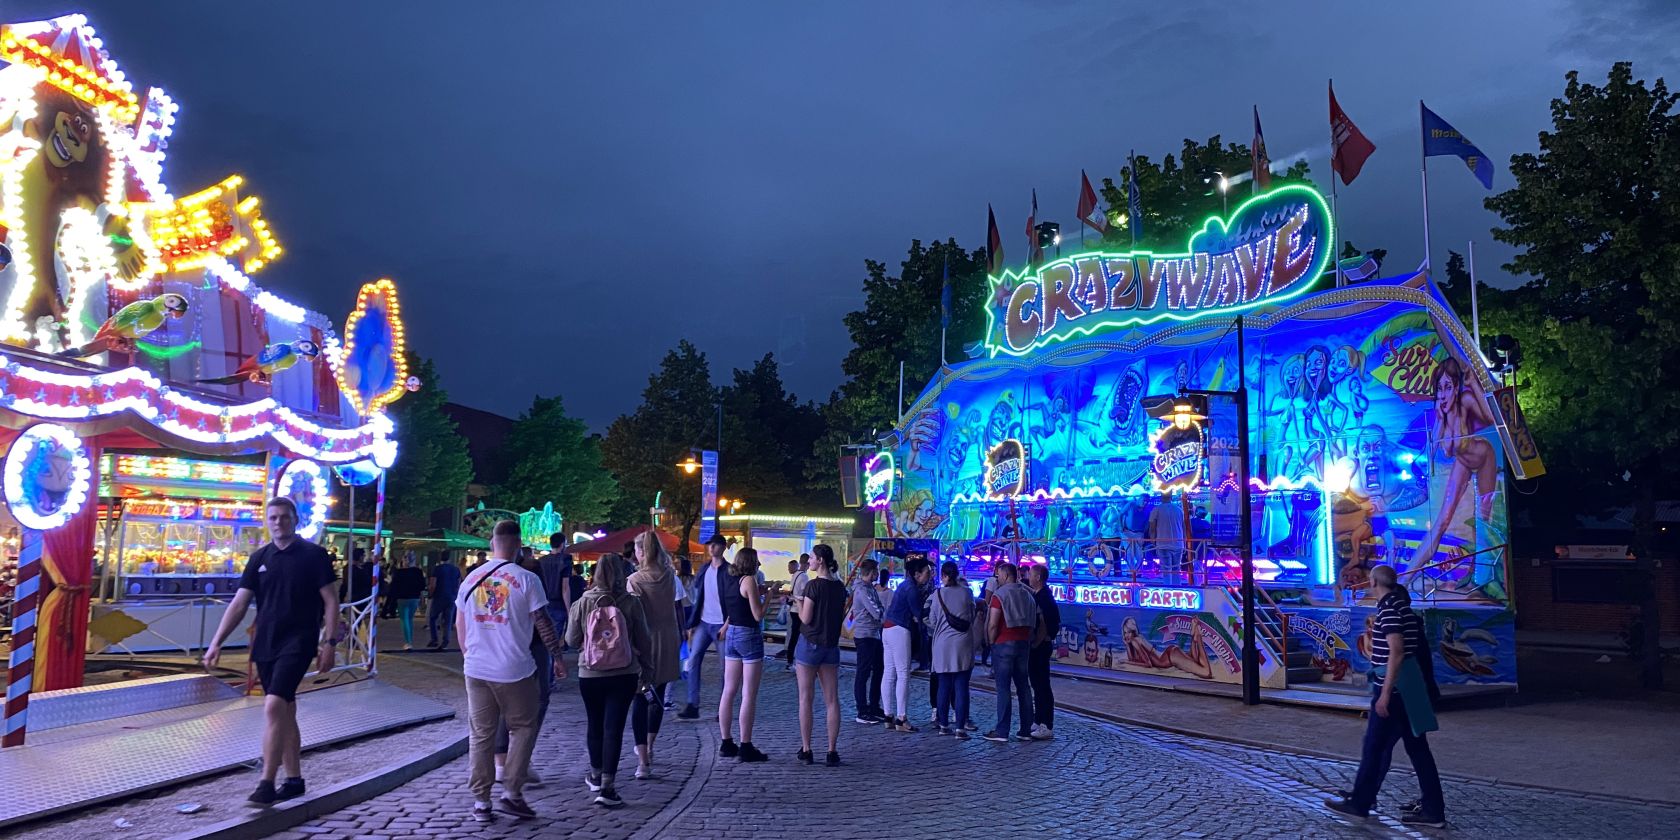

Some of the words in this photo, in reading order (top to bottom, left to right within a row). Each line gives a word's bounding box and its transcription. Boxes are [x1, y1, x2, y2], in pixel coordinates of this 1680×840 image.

[1005, 202, 1317, 351] CRAZYWAVE
[1381, 335, 1437, 374] Surf
[1210, 436, 1241, 449] 2022
[1154, 441, 1200, 473] CRAZY
[1083, 588, 1133, 606] BEACH
[1139, 589, 1197, 609] PARTY
[1174, 616, 1211, 637] Sumer
